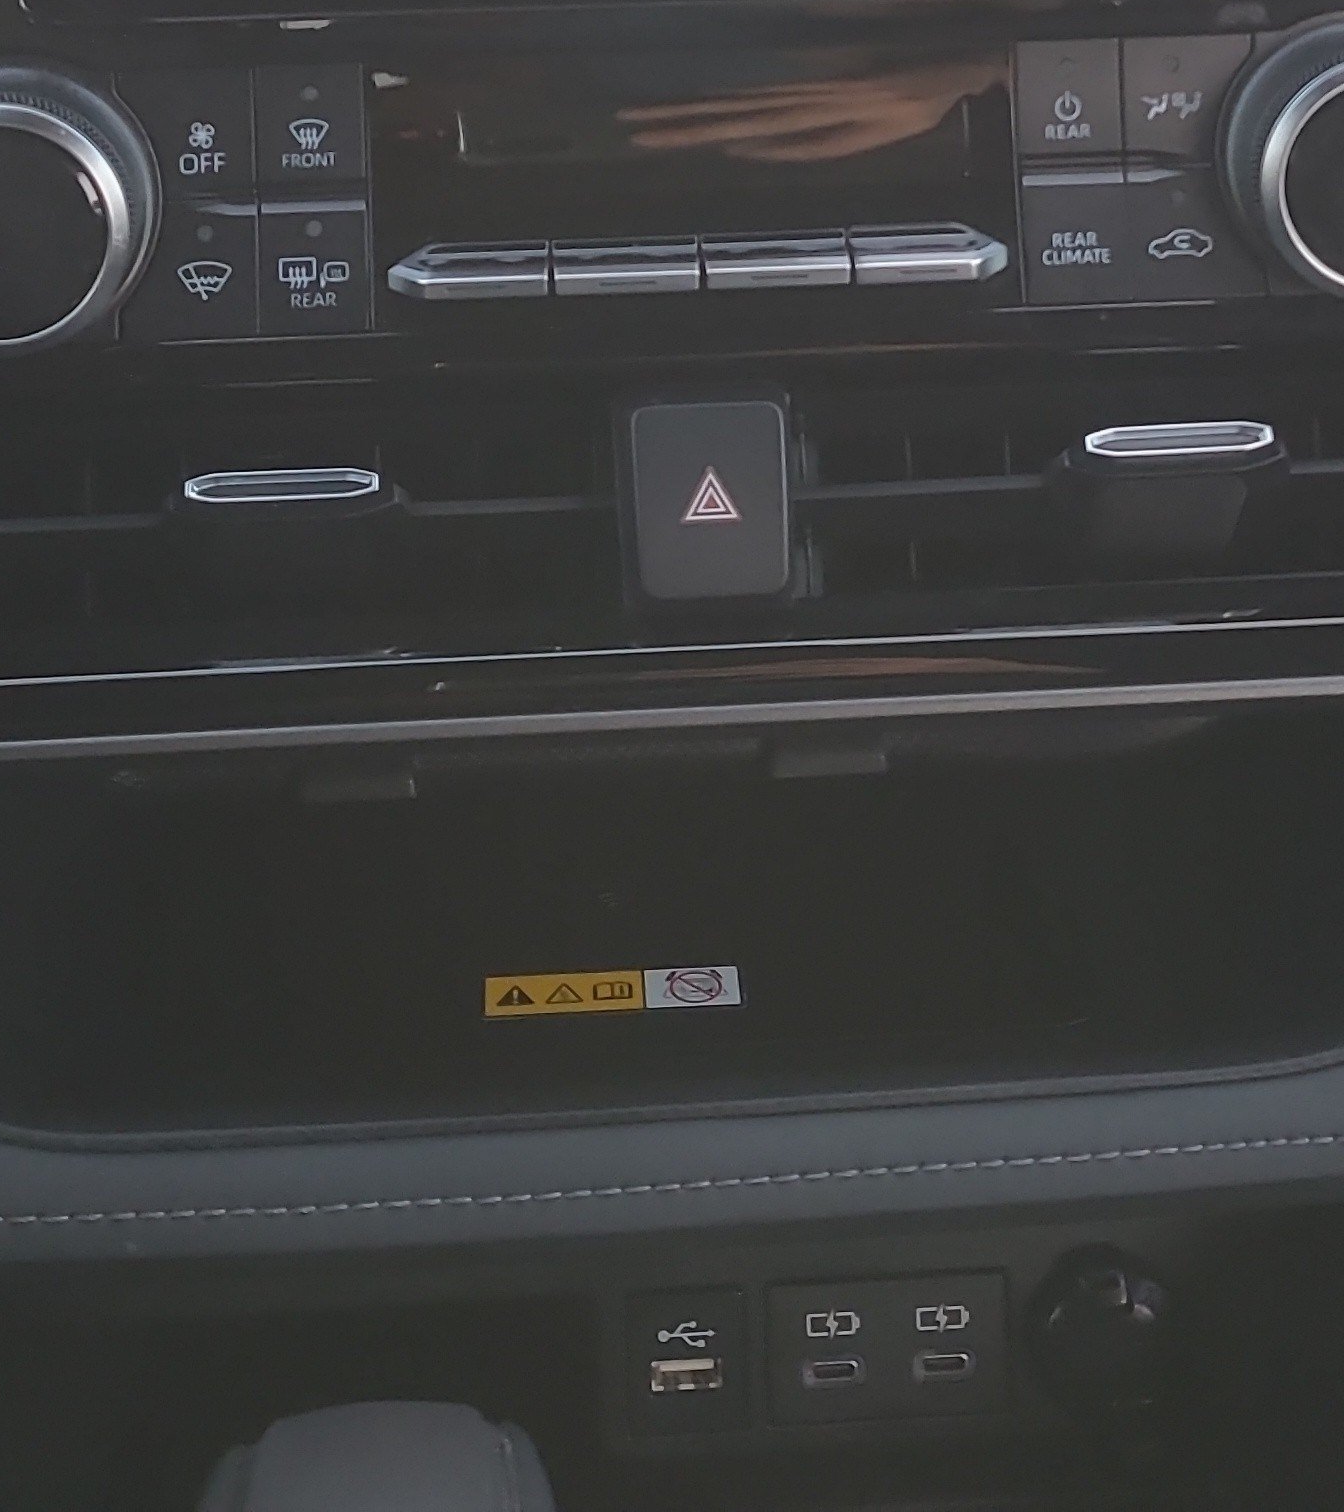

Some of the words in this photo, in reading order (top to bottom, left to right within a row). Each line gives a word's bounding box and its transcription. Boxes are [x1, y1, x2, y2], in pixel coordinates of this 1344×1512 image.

[1045, 123, 1092, 139] REAR
[179, 152, 227, 175] OFF
[282, 151, 336, 168] FRONT
[1052, 231, 1099, 248] REAR
[1042, 248, 1112, 265] CLIMATE
[291, 292, 338, 308] REAR
